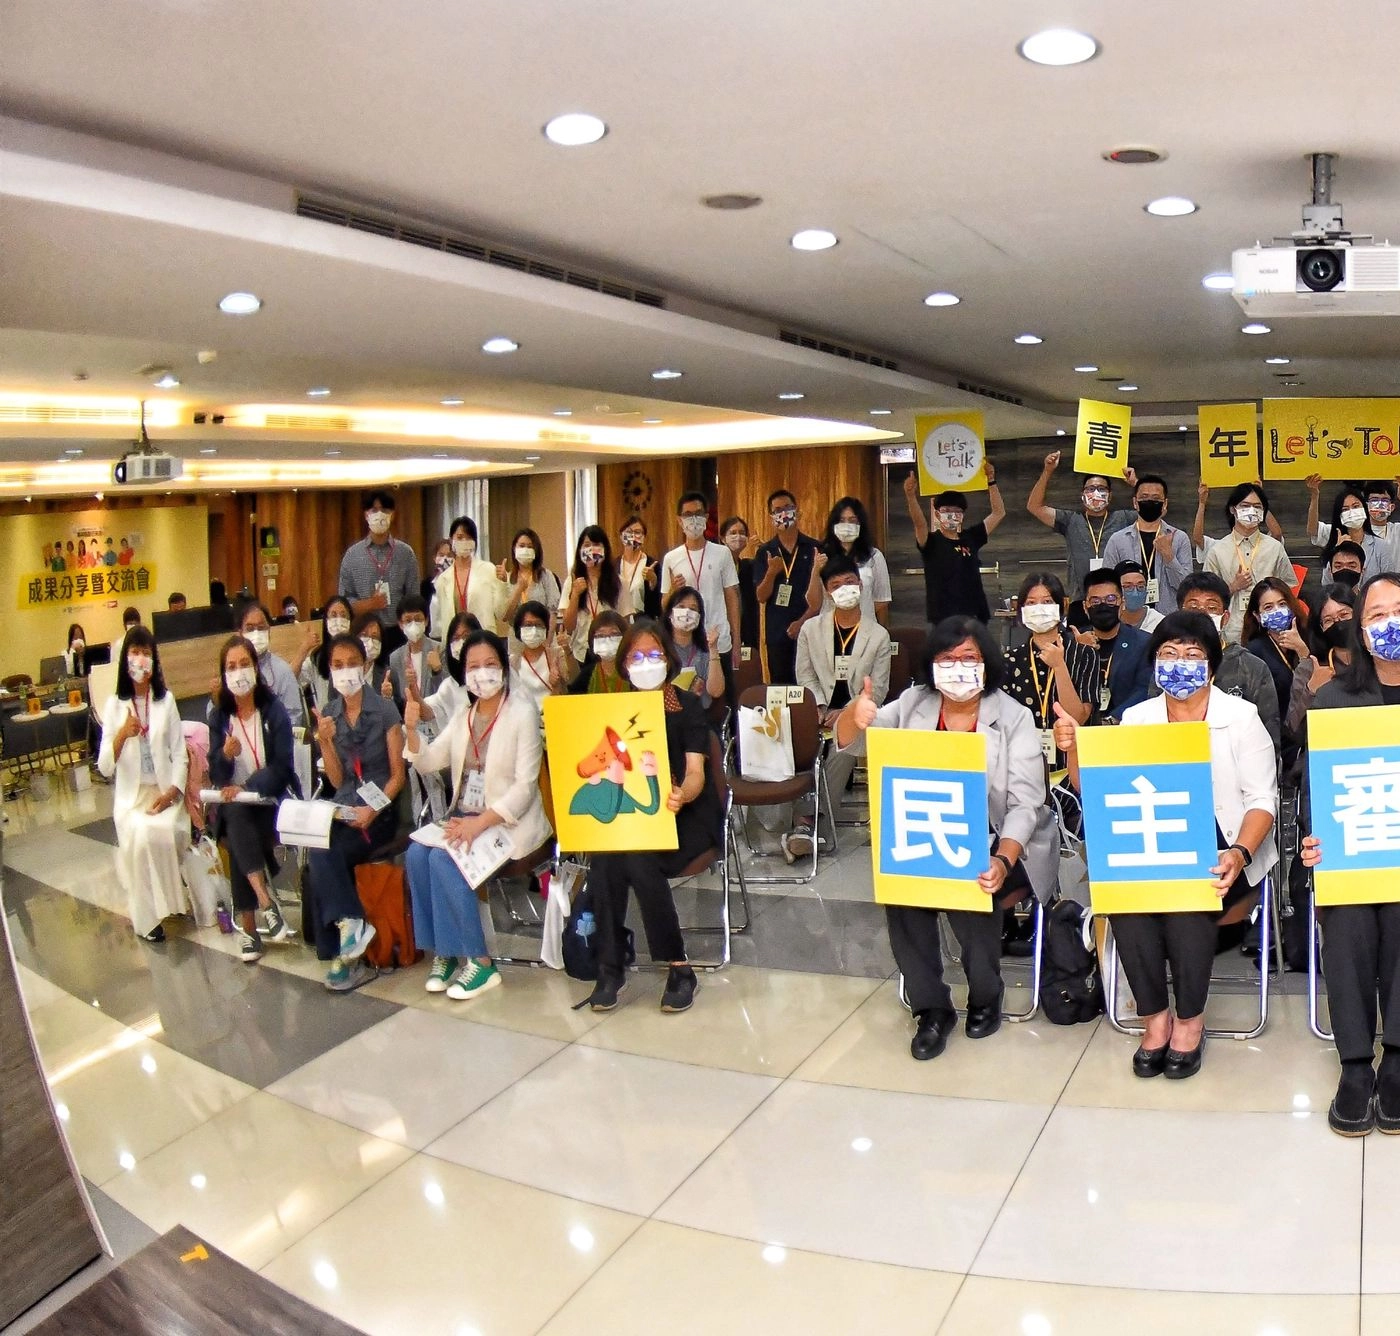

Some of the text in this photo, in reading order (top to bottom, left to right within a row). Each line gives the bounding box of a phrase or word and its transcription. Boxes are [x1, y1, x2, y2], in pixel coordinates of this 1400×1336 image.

[938, 438, 967, 456] Let's
[1086, 421, 1123, 459] 青
[1208, 427, 1250, 467] 年
[1270, 424, 1349, 463] Let's
[946, 452, 974, 469] Talk
[28, 566, 151, 604] 成果分享暨交流會
[788, 690, 802, 698] A20
[891, 778, 971, 868] 民
[1104, 775, 1198, 867] 主
